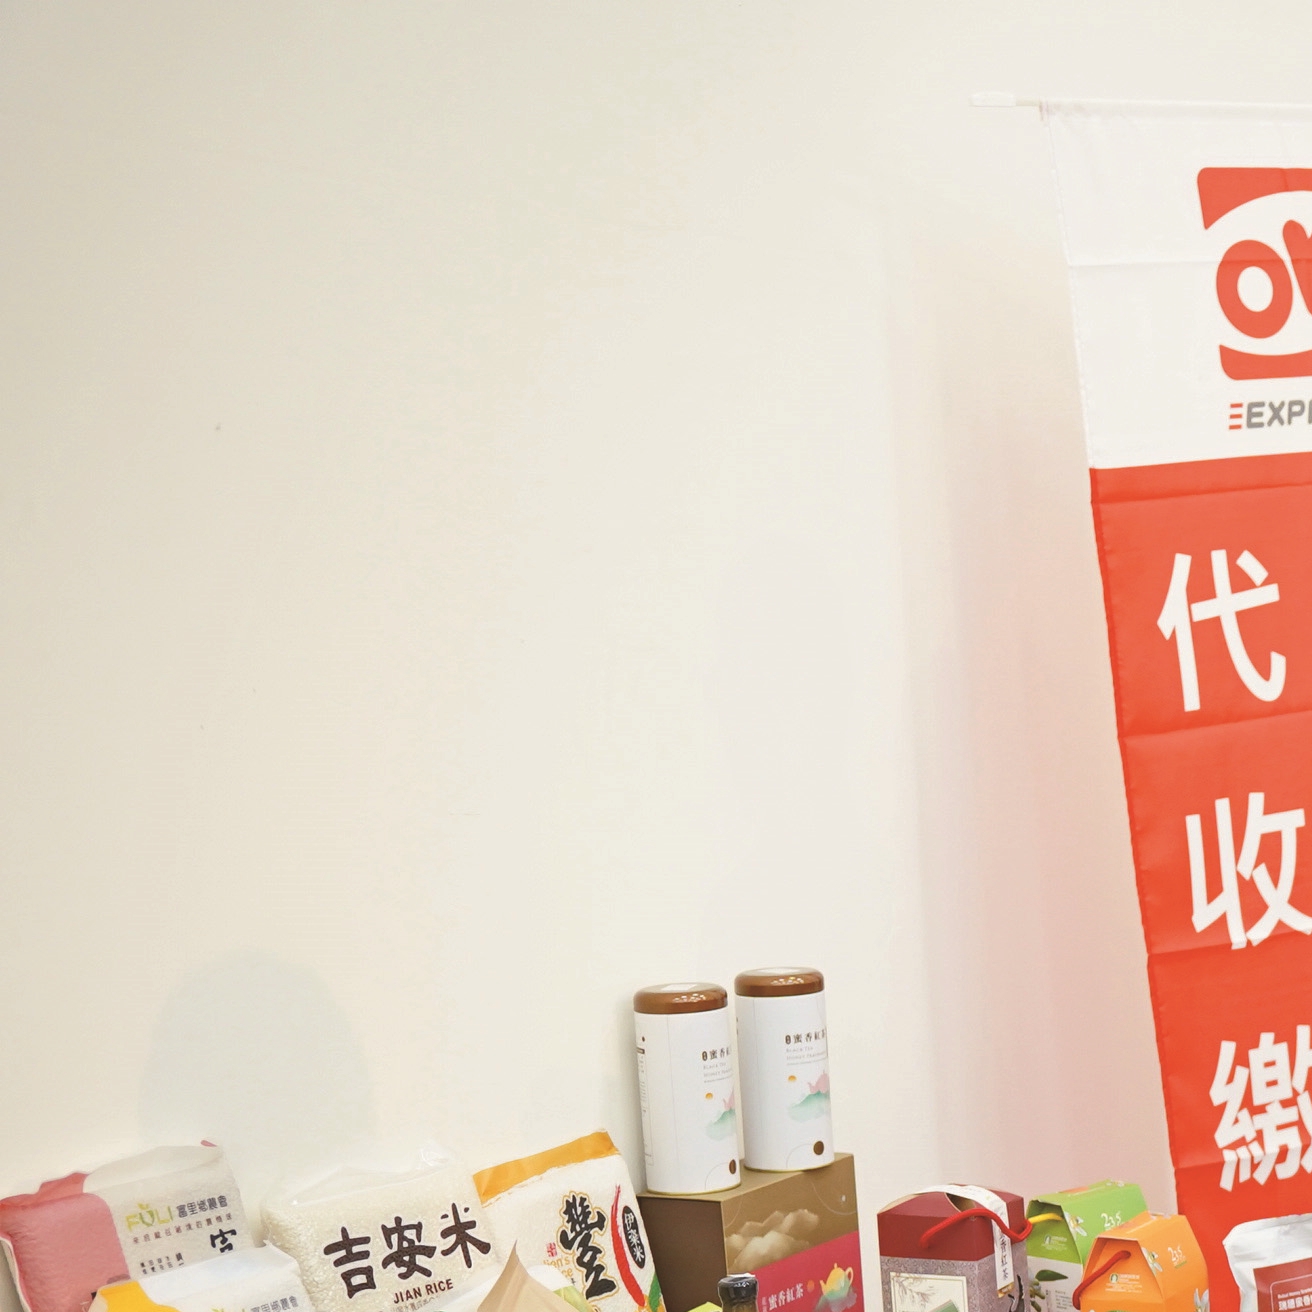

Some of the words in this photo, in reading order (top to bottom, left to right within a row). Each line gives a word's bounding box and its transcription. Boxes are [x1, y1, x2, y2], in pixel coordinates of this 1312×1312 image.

[125, 1202, 173, 1231] FULI
[323, 1202, 491, 1299] 吉安米
[393, 1287, 422, 1304] JIAN
[426, 1279, 454, 1298] RICE
[768, 1283, 804, 1310] 蜜香紅茶
